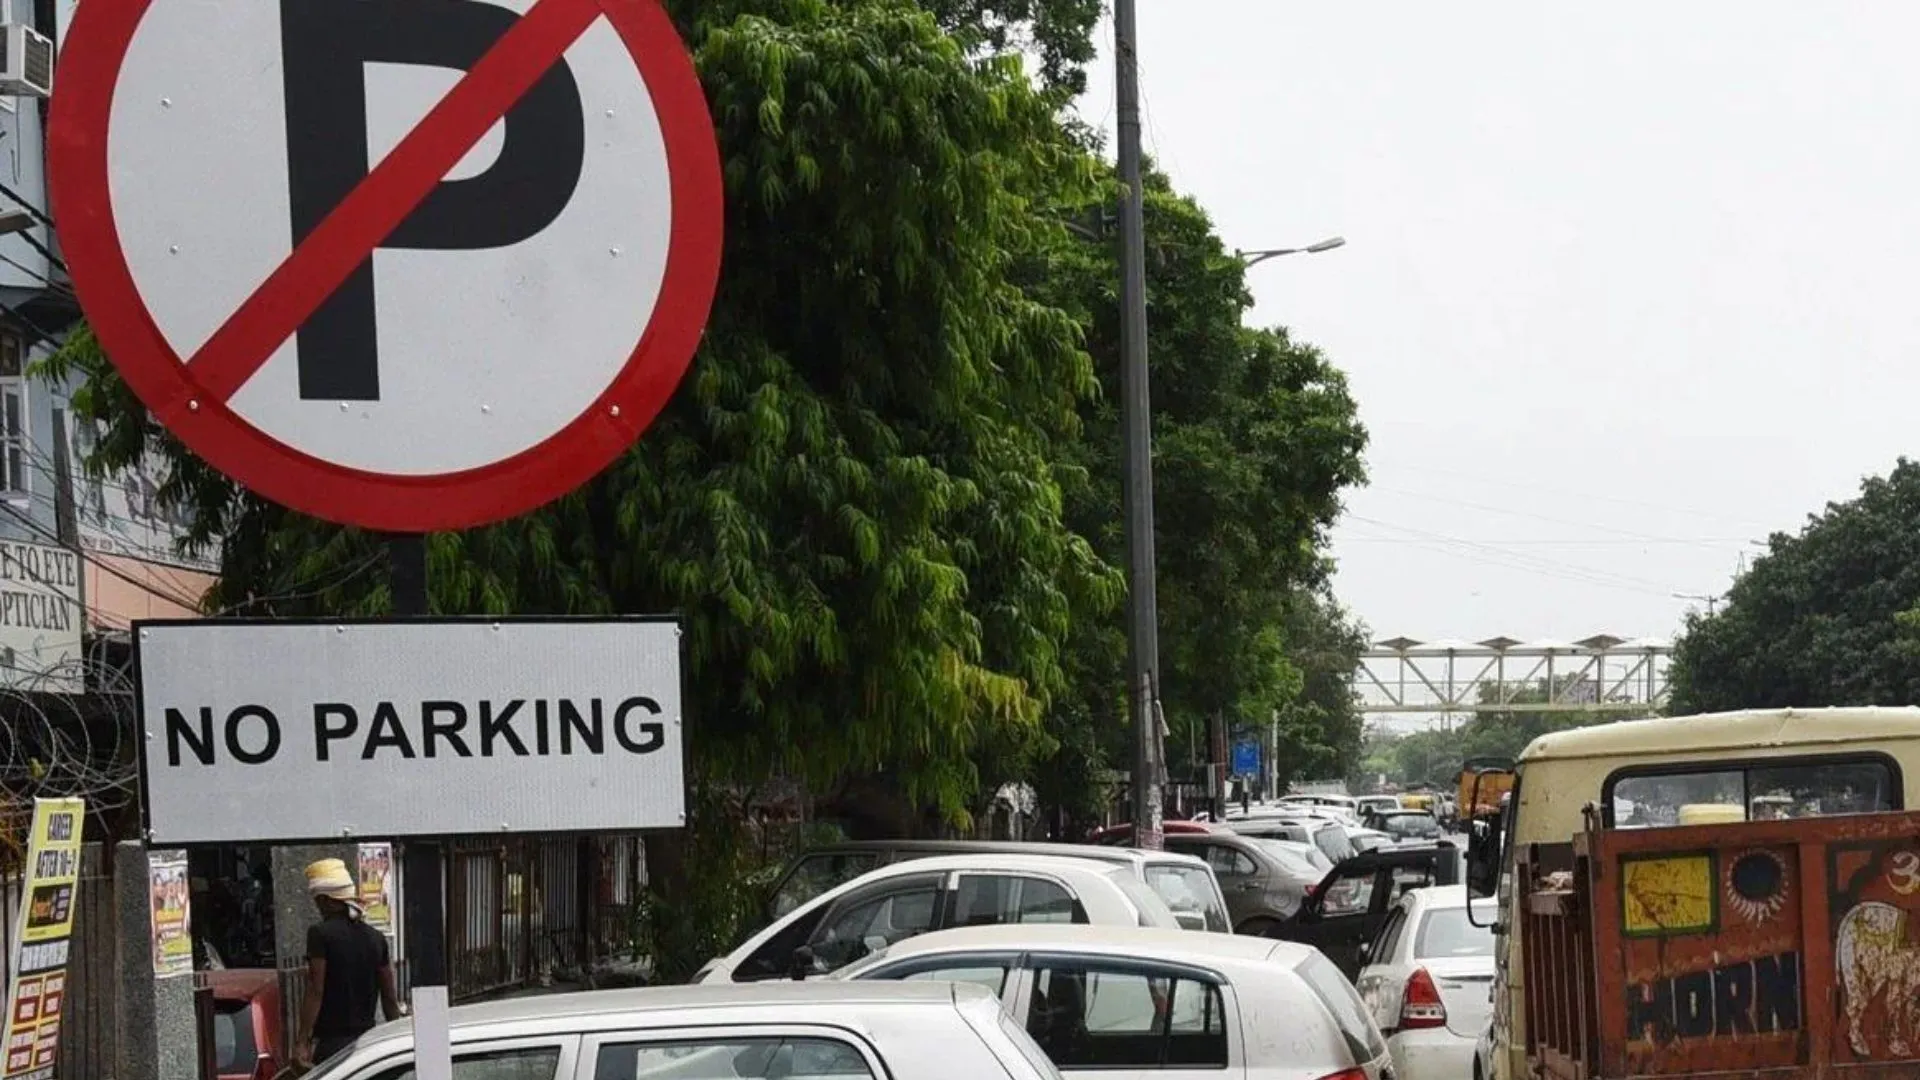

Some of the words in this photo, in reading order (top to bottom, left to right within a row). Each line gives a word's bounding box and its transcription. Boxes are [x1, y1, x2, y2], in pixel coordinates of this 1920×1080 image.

[282, 0, 585, 401] P
[15, 545, 40, 582] TO
[43, 548, 76, 587] EYE
[0, 591, 70, 632] PTICIAN
[165, 704, 281, 767] NO
[313, 695, 665, 762] PARKING
[1625, 951, 1801, 1042] HORN
